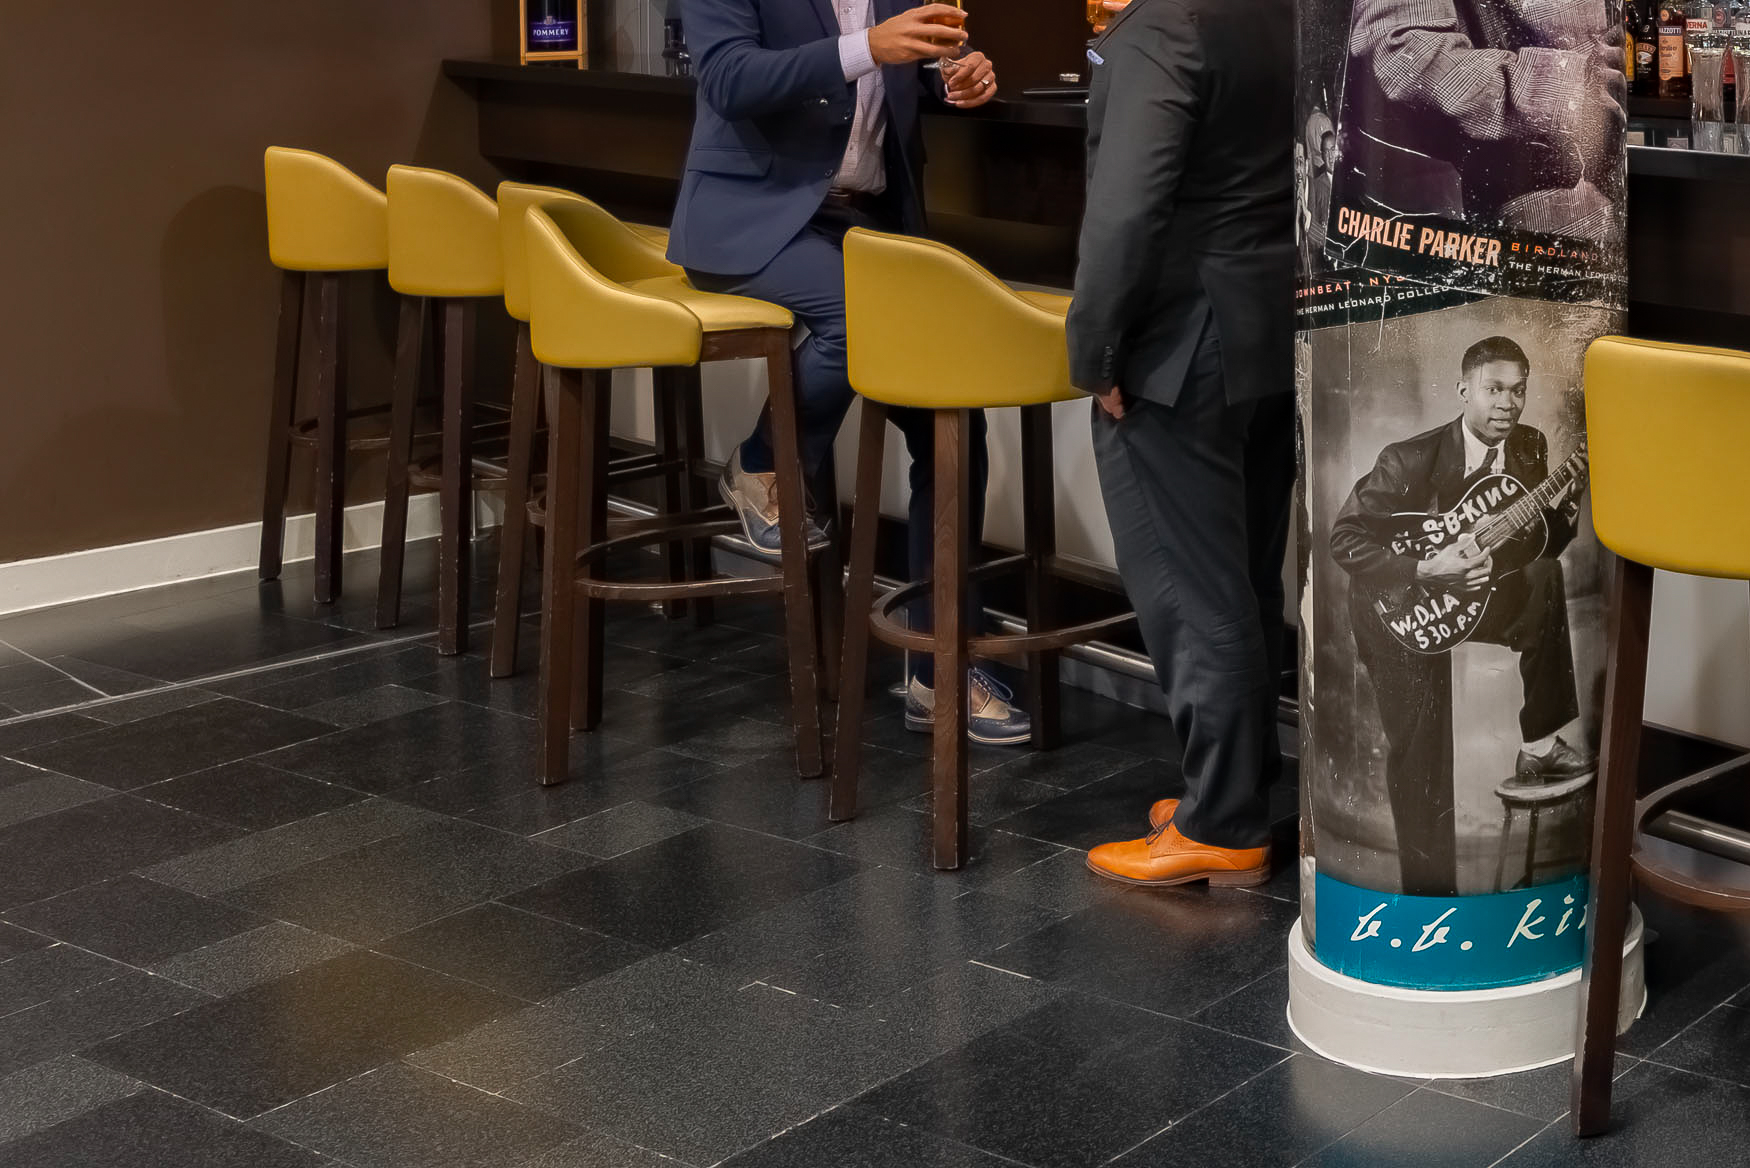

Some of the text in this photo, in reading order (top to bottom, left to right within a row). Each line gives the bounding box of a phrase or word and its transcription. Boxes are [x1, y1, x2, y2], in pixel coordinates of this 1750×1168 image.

[533, 28, 569, 37] POMMERY
[1338, 206, 1501, 267] CHARLIE PARKER
[1511, 242, 1599, 262] BIRDLAND
[1509, 261, 1532, 271] THE
[1537, 265, 1581, 277] HERMAN
[1338, 293, 1392, 310] LEONARD
